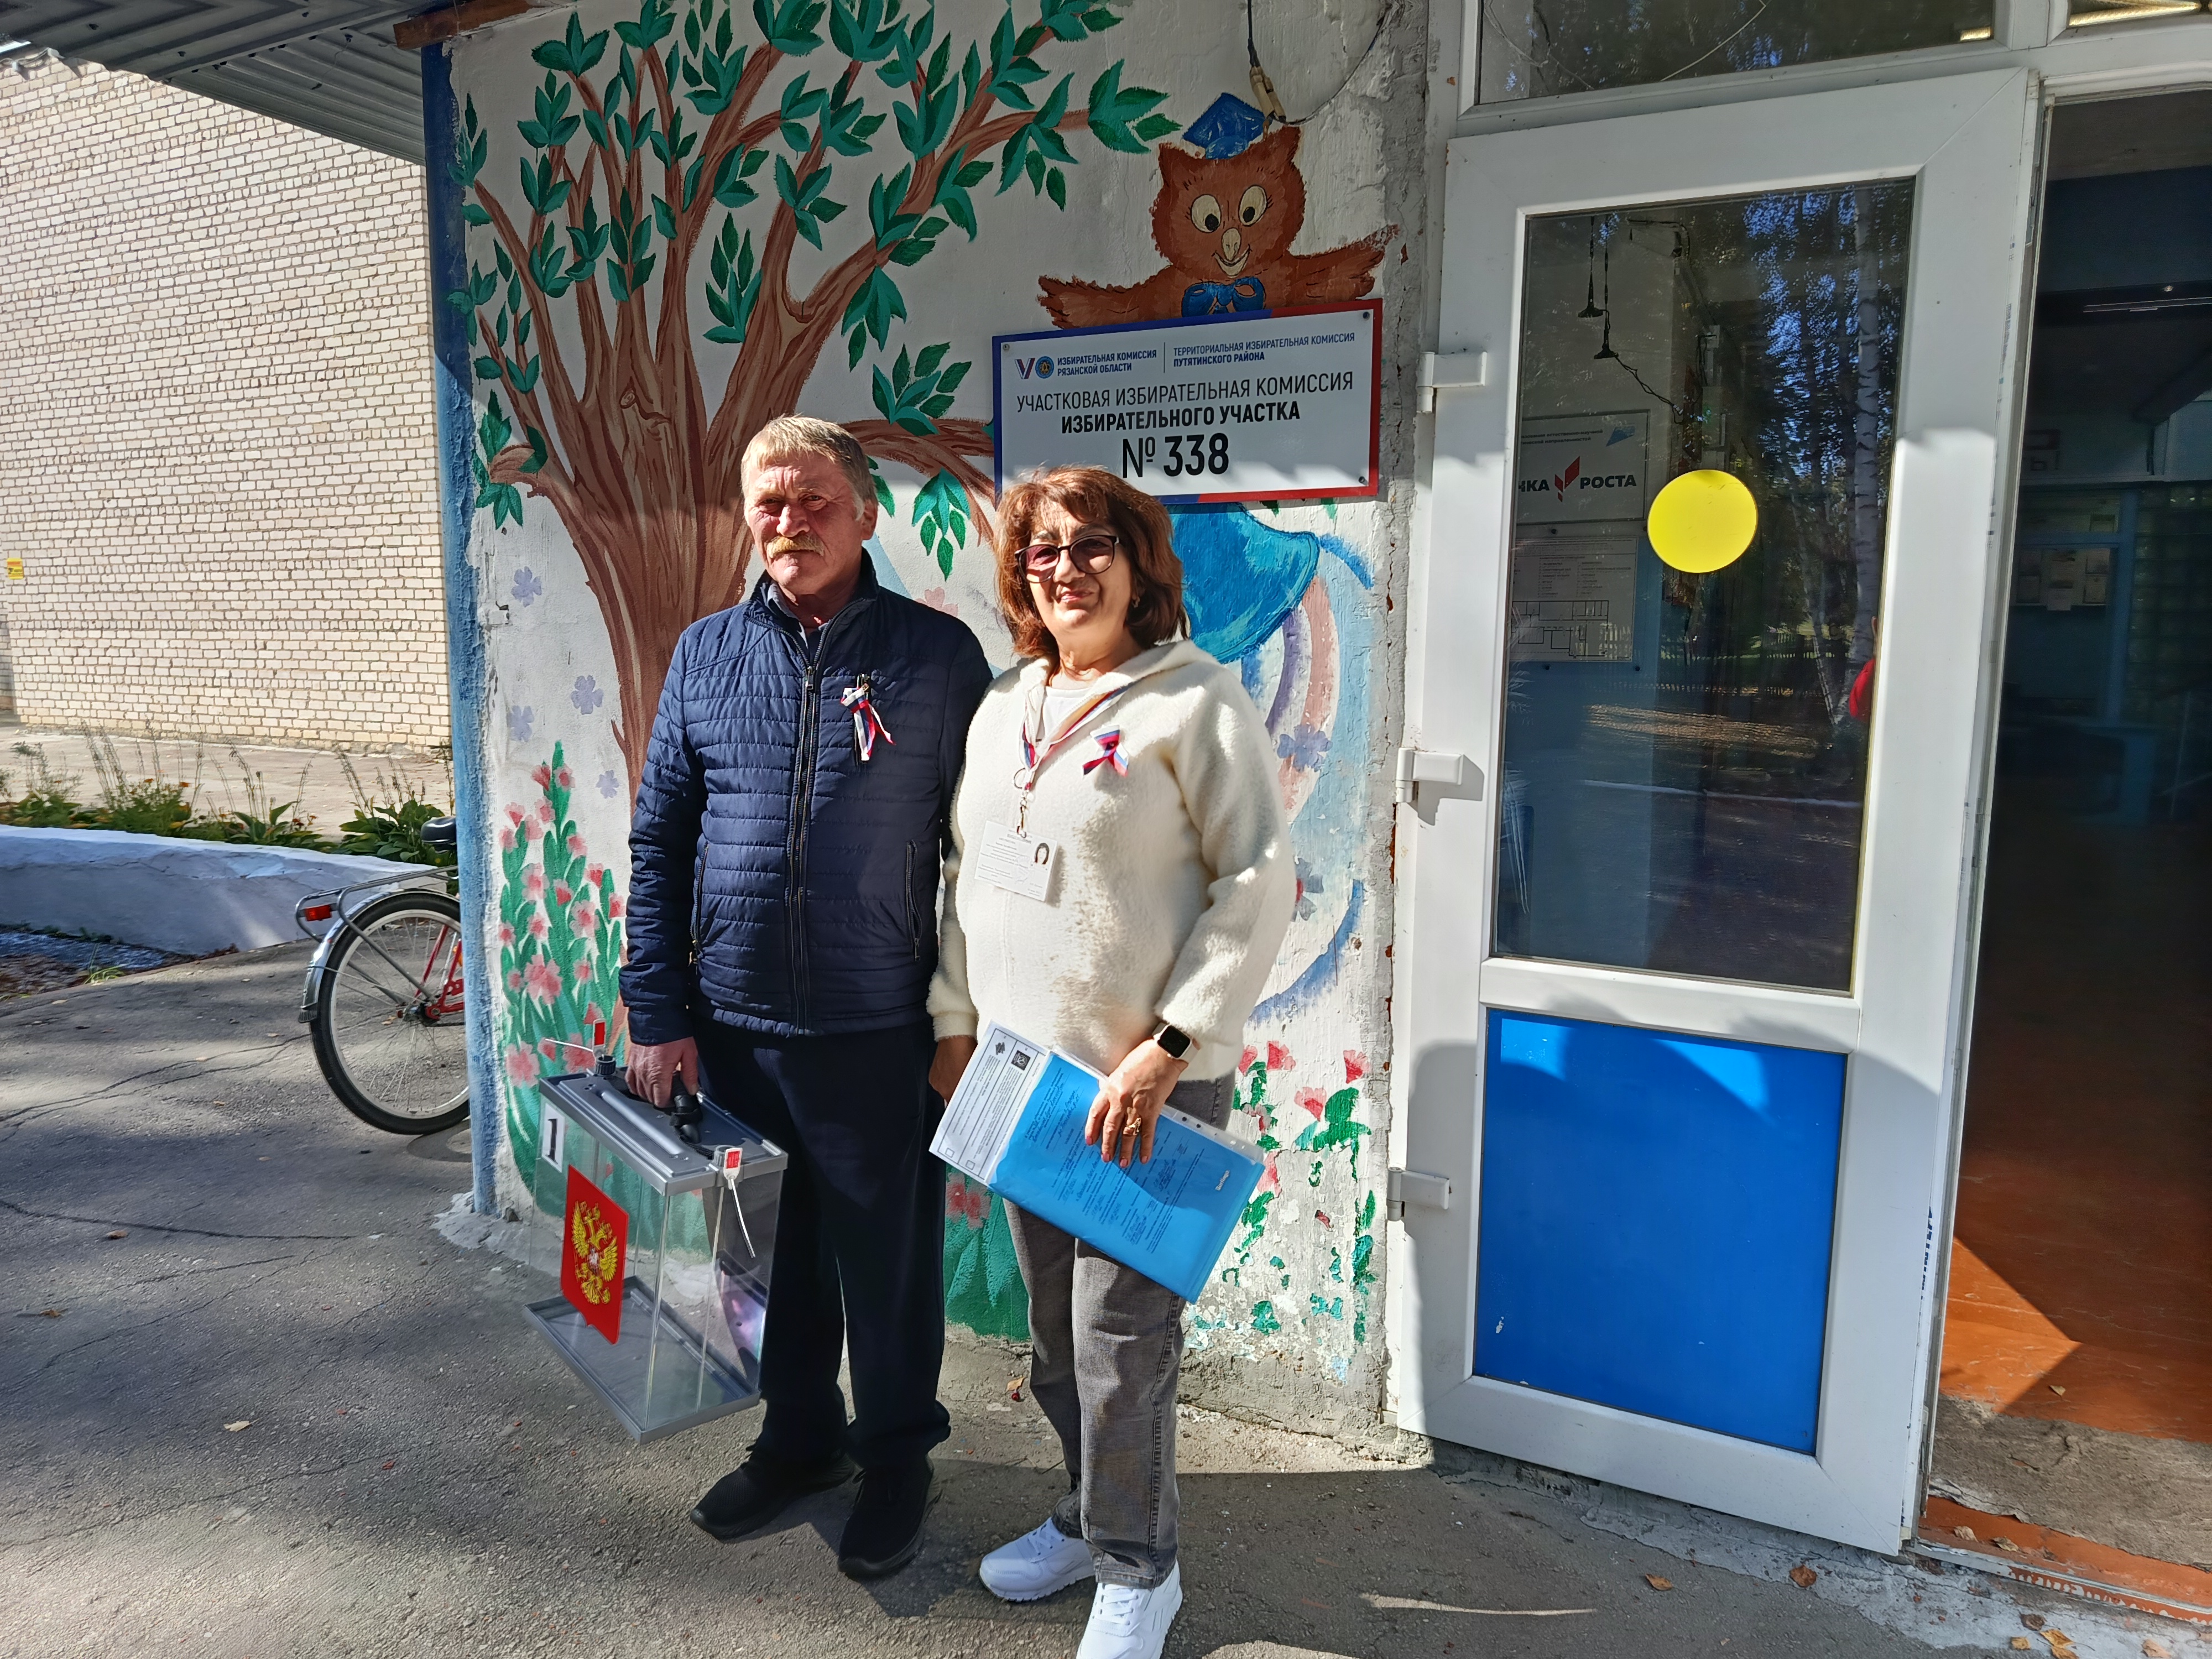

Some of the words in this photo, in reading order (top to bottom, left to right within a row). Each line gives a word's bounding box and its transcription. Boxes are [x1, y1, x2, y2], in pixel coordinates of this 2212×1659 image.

[1173, 342, 1244, 357] ТЕРРИТОРИАЛЬНАЯ
[1245, 336, 1309, 350] ИЗБИРАТЕЛЬНАЯ
[1311, 332, 1355, 345] КОМИССИЯ
[1057, 353, 1115, 366] ИЗБИРАТЕЛЬНАЯ
[1117, 349, 1157, 361] КОМИССИЯ
[1057, 363, 1098, 377] РЯЗАНСКОЙ
[1099, 362, 1132, 373] ОБЛАСТИ
[1173, 356, 1232, 367] ПУТЯТИНСКОГО
[1234, 351, 1265, 363] РАЙОНА
[1016, 389, 1110, 413] УЧАСТКОВАЯ
[1116, 379, 1250, 406] ИЗБИРАТЕЛЬНАЯ
[1256, 371, 1354, 397] КОМИССИЯ
[1061, 406, 1215, 434] ИЗБИРАТЕЛЬНОГО
[1219, 401, 1300, 425] УЧАСТКА
[1123, 436, 1156, 478] №
[1163, 432, 1229, 477] 338
[1580, 474, 1637, 489] РОСТА
[545, 1118, 559, 1165] 1
